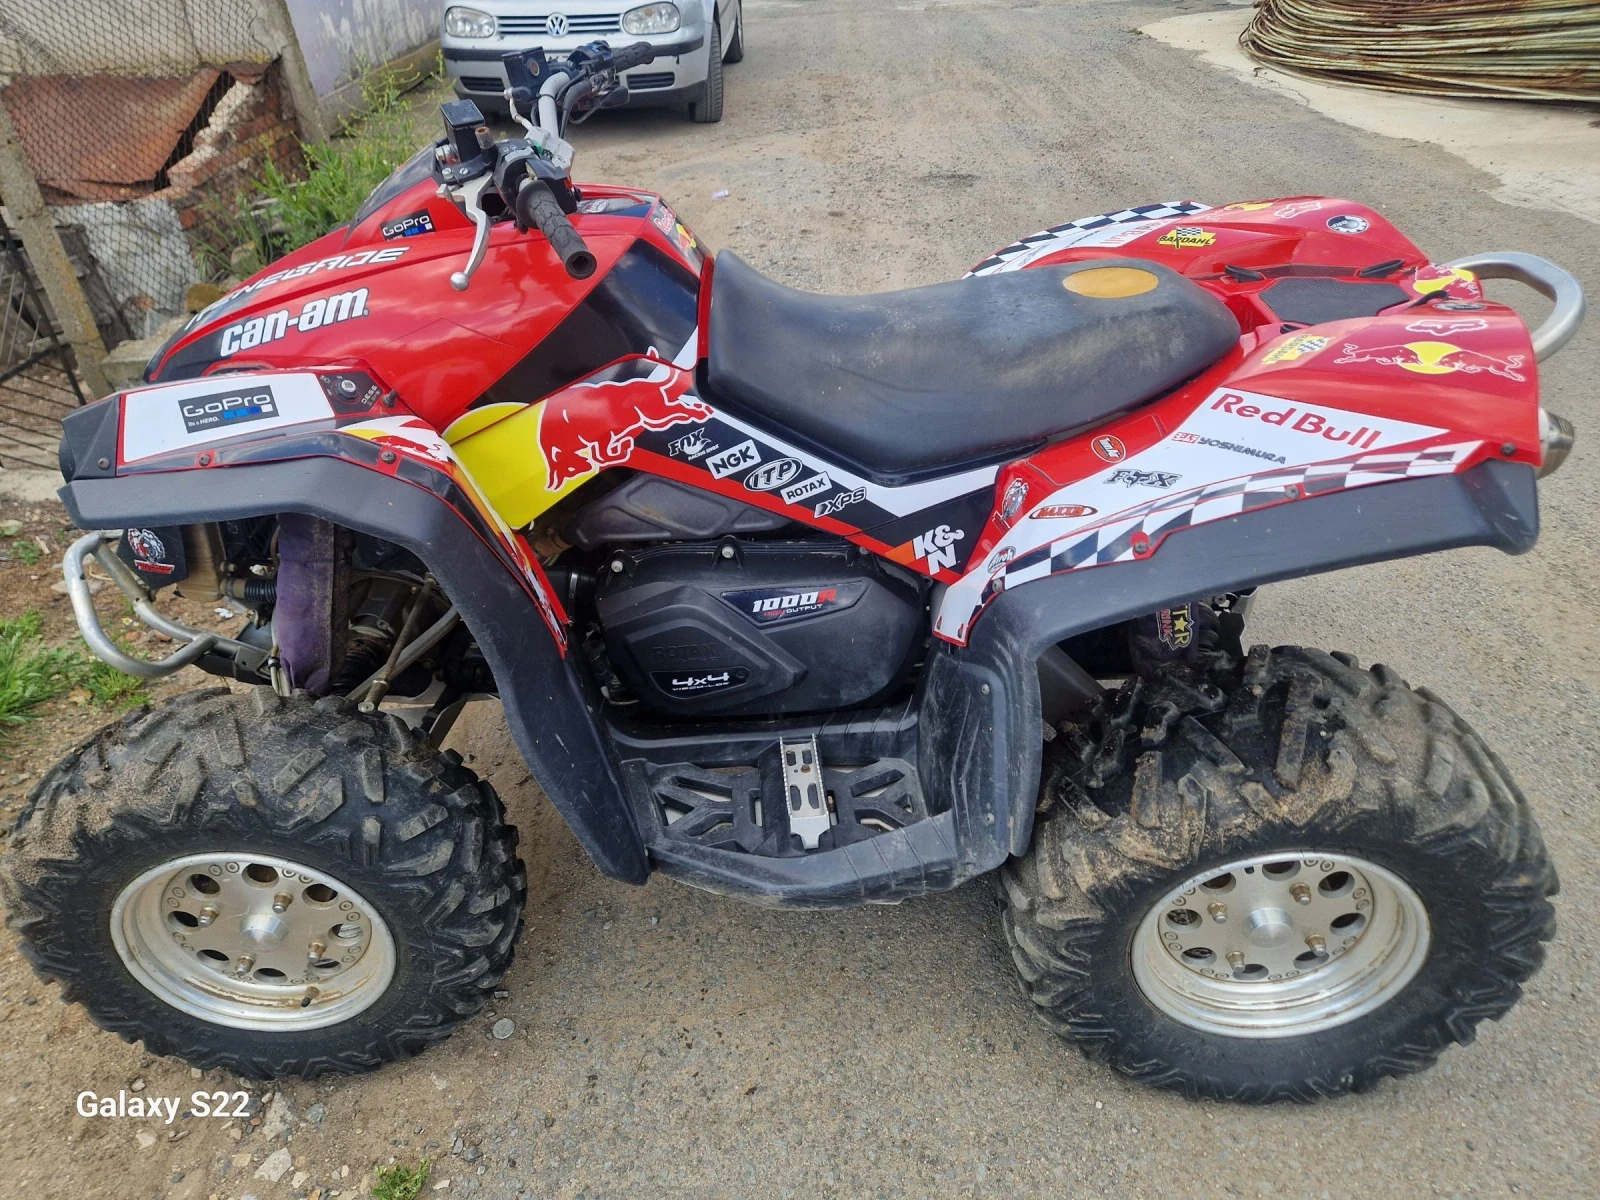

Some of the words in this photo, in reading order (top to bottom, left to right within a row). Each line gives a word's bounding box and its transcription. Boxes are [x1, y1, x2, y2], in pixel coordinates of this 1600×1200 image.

[383, 215, 430, 236] GoPro
[1159, 234, 1211, 246] BARDAHL
[185, 247, 410, 331] NEGADE
[183, 394, 270, 417] GoPro
[1210, 393, 1297, 427] Red
[1291, 412, 1382, 450] Bull
[711, 445, 755, 475] NGK
[1198, 436, 1287, 464] YOSHIMURA
[751, 459, 793, 489] ITP
[786, 477, 827, 500] ROTAX
[826, 487, 867, 514] XPS
[752, 588, 837, 613] 1000R
[786, 604, 823, 614] OUTPUT
[672, 672, 730, 686] 4x4
